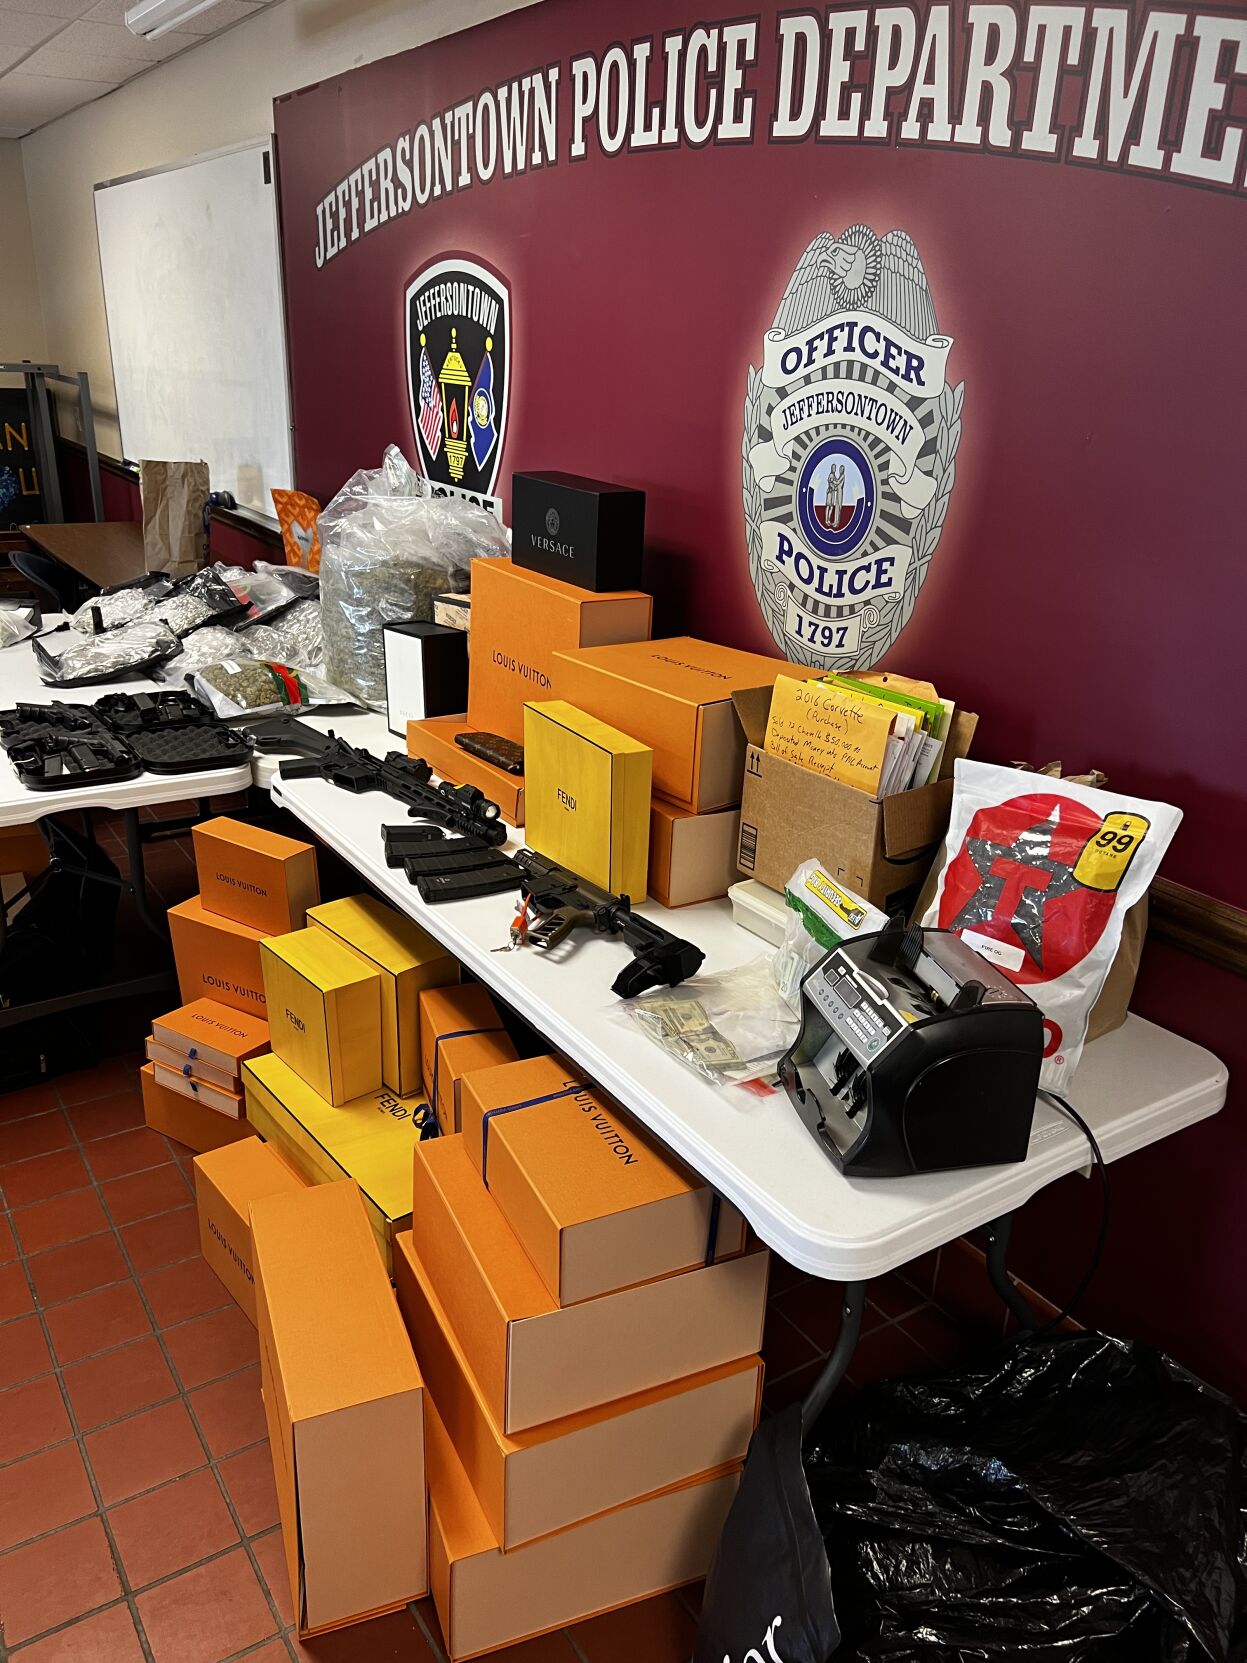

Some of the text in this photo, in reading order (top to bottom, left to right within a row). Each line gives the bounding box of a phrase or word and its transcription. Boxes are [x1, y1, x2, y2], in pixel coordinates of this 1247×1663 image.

[314, 4, 1247, 268] JEFFERSONTOWN POLICE DEPARTME
[416, 281, 499, 335] JEFFERSONTOWN
[780, 321, 926, 386] OFFICER
[781, 389, 914, 446] JEFFERSONTOWN
[448, 453, 464, 467] 1797
[531, 534, 575, 559] VERSACE
[775, 532, 895, 599] POLICE
[794, 613, 849, 649] 1797
[492, 650, 552, 689] LOUIS VUITTON
[651, 654, 732, 680] LOUIS VUITTON
[795, 689, 818, 708] 2016
[822, 698, 864, 724] Corvette
[557, 787, 577, 812] FENDI
[1095, 830, 1135, 853] 99
[216, 872, 268, 898] LOUIS VUITTON
[202, 974, 266, 1004] LOUIS VUITTO
[191, 1012, 248, 1039] LOUIS VUITTON
[285, 1008, 306, 1033] FENDI
[374, 1093, 412, 1120] FENDI
[562, 1080, 639, 1166] LUIS VUITTON
